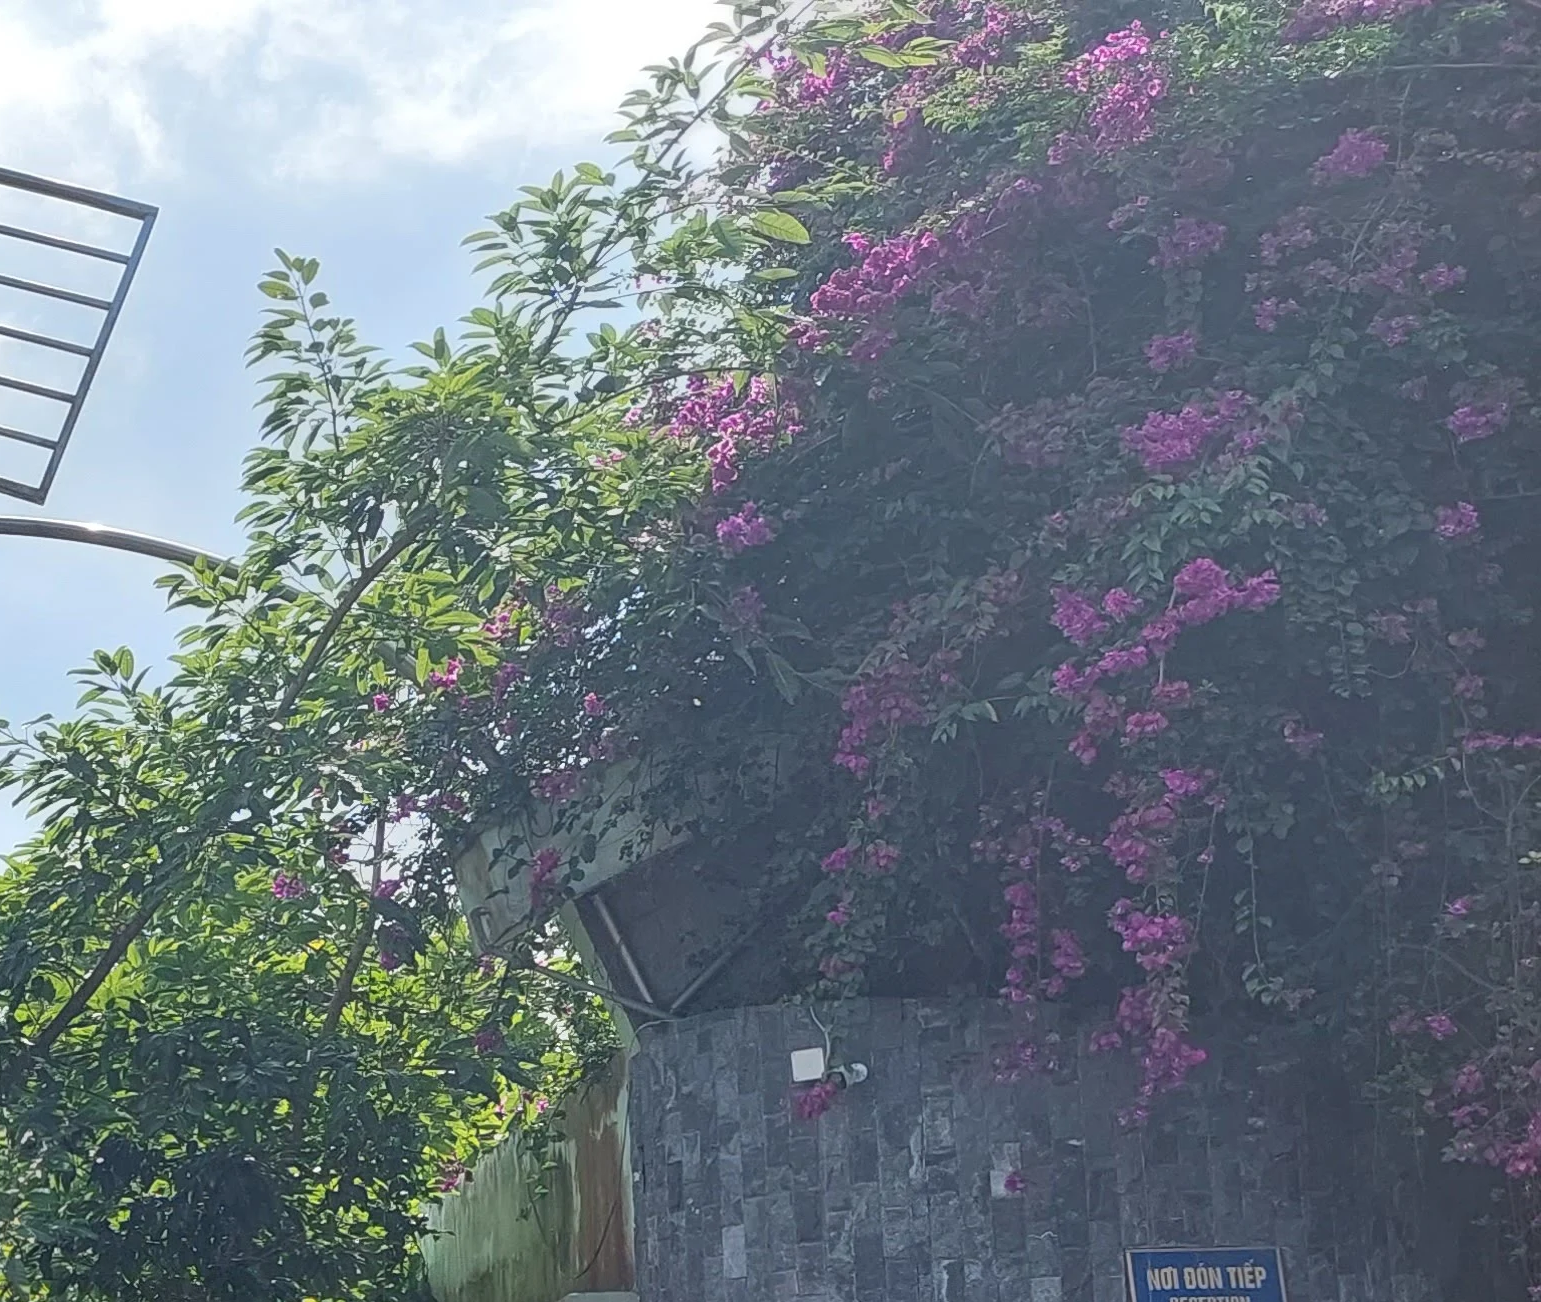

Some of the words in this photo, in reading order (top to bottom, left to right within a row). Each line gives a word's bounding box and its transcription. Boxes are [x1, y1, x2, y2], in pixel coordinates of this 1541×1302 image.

[1147, 1265, 1180, 1291] NƠI
[1183, 1262, 1224, 1290] ĐÓN
[1226, 1258, 1267, 1290] TIẾP
